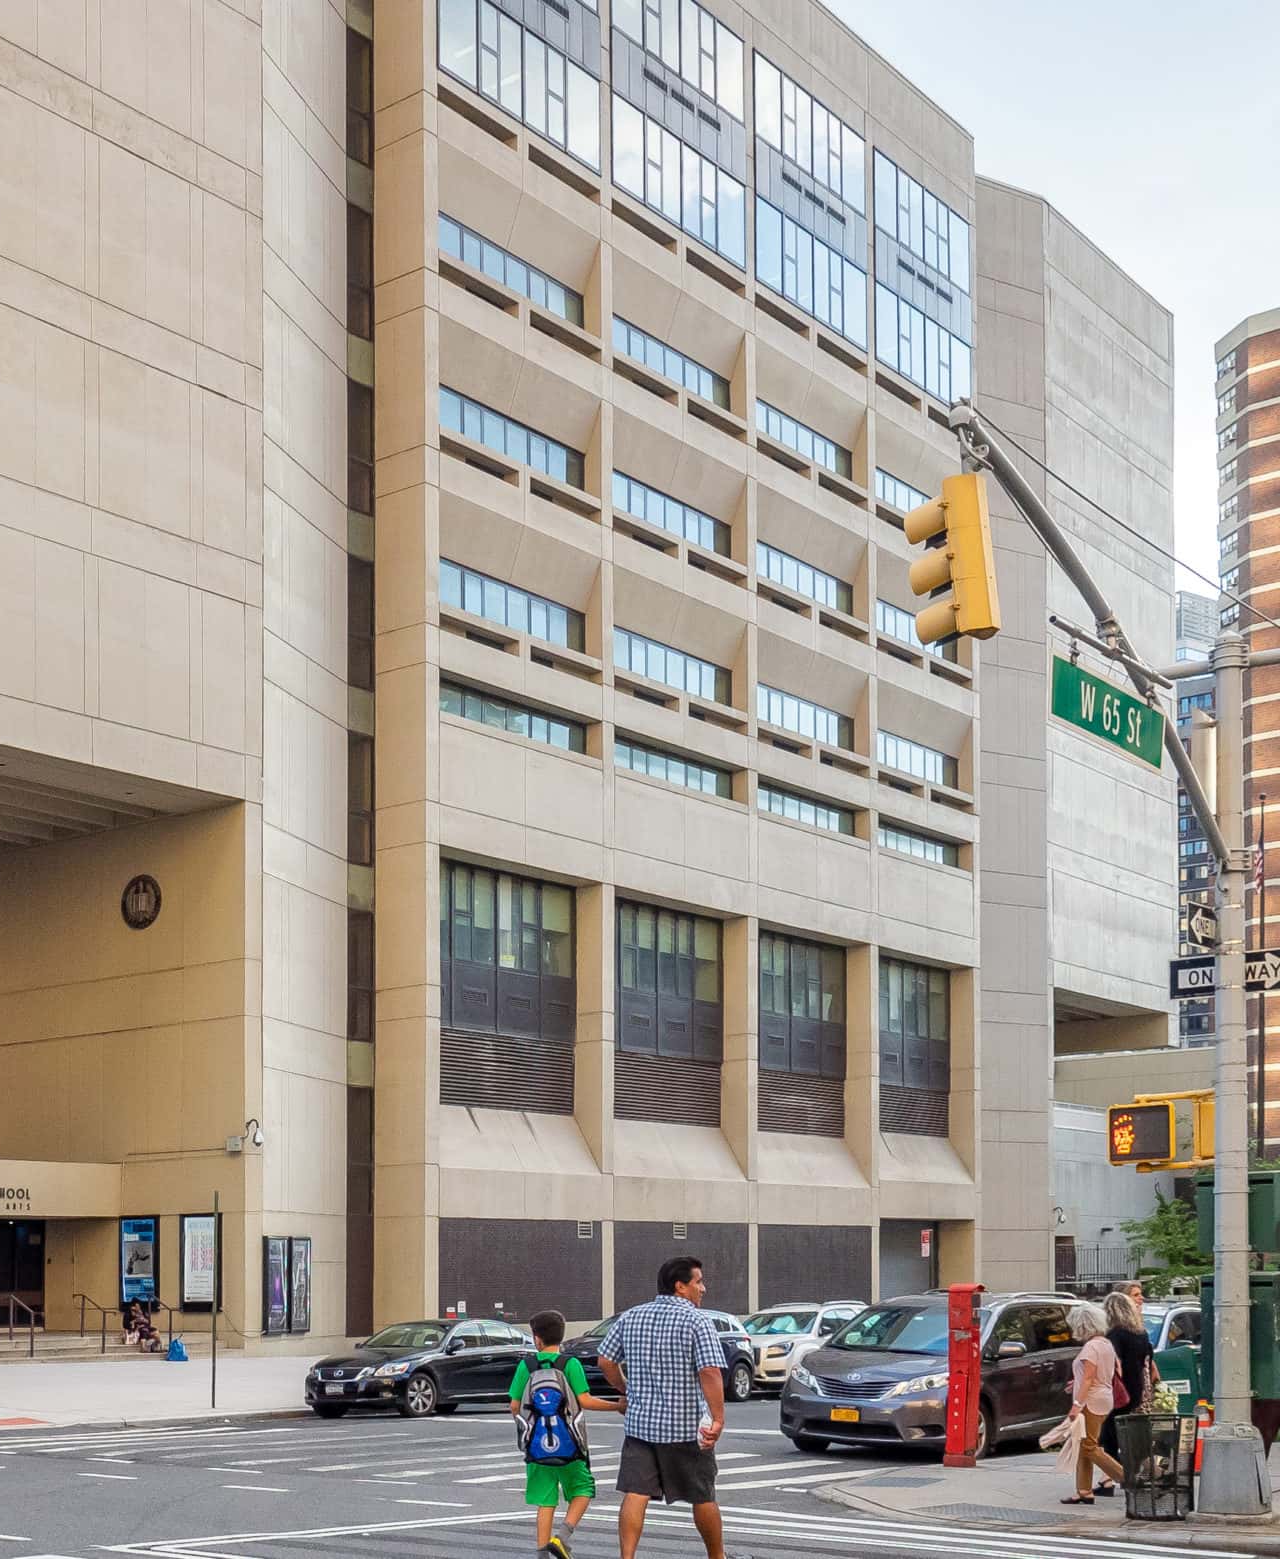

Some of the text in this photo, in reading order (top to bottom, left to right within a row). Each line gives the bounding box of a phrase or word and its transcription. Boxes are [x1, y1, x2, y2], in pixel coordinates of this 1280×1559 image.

[1081, 681, 1141, 747] W 65 St
[1188, 961, 1280, 986] ON WAY
